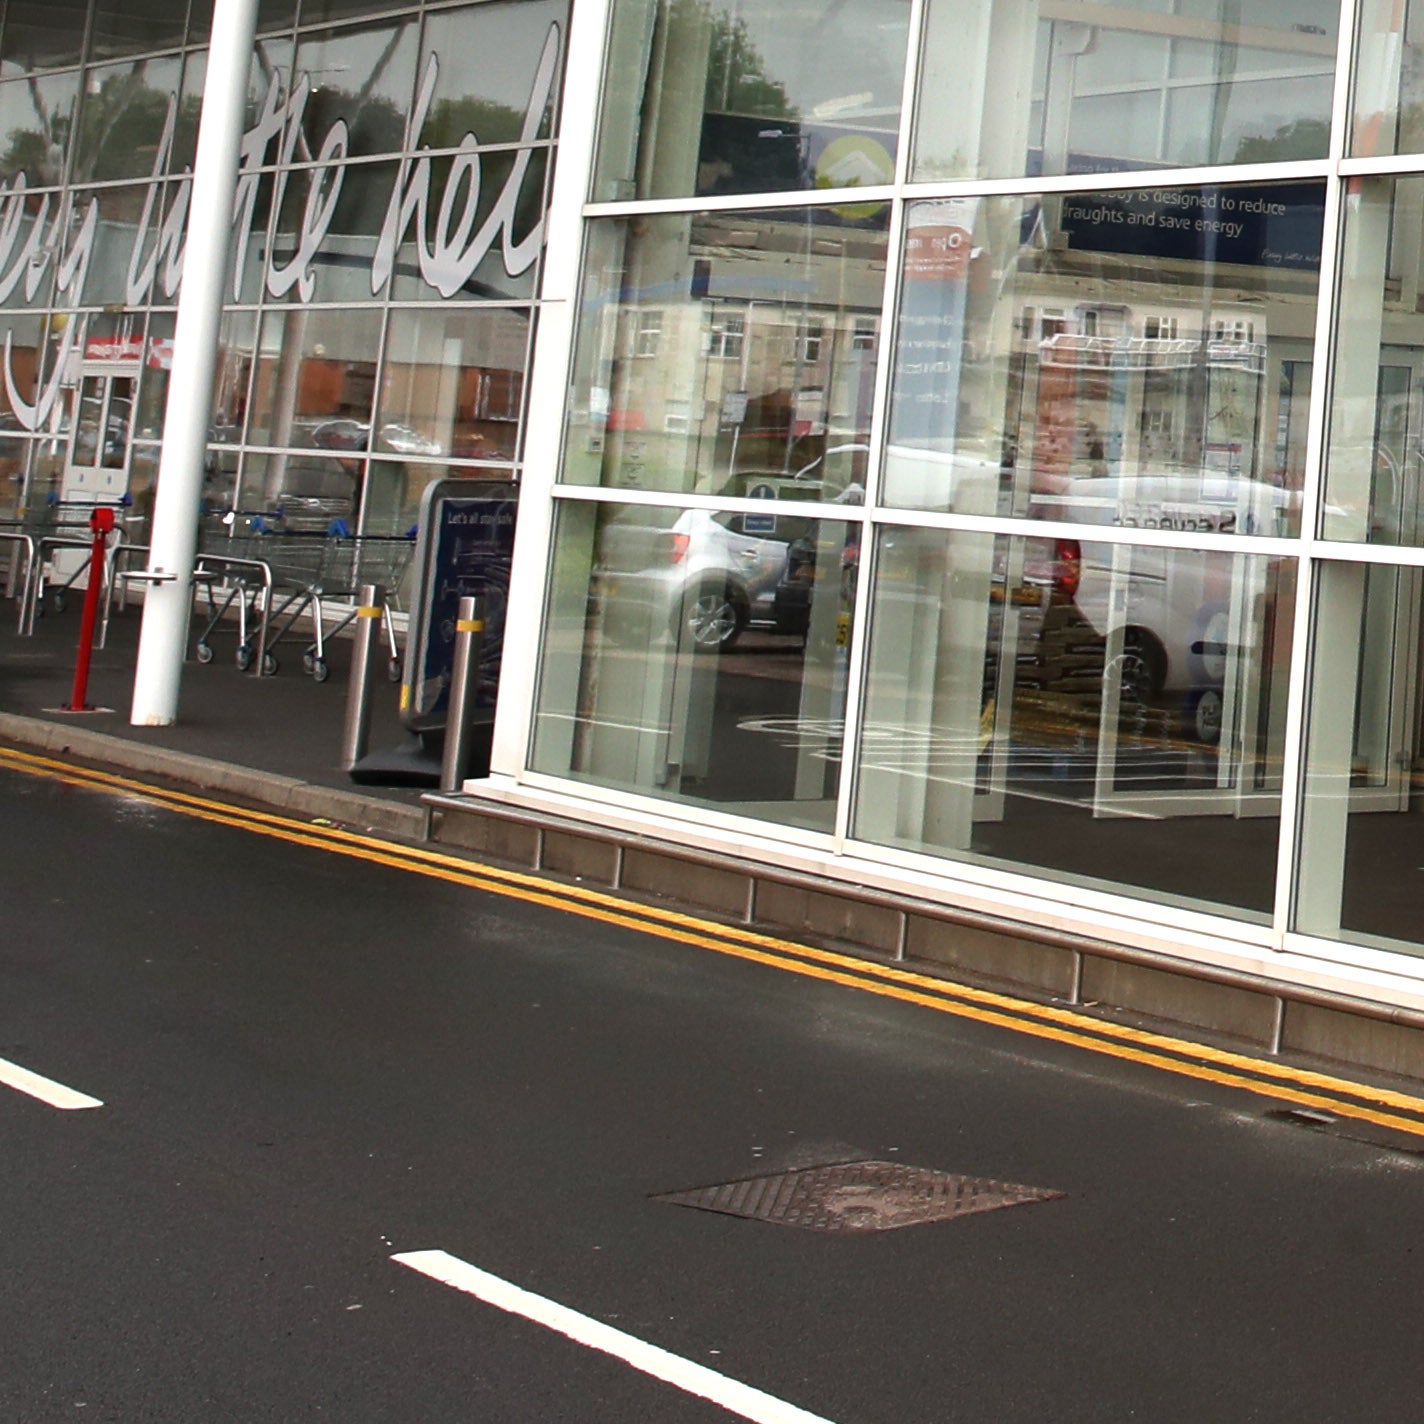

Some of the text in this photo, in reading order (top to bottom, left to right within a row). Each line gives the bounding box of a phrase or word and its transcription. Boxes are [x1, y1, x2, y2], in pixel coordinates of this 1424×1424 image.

[126, 66, 349, 305] litle
[371, 20, 560, 298] hel
[1153, 190, 1217, 210] designed
[1221, 196, 1235, 209] to
[1239, 197, 1286, 216] reduce
[1127, 211, 1155, 226] and
[1159, 215, 1190, 230] save
[1194, 219, 1243, 238] energy
